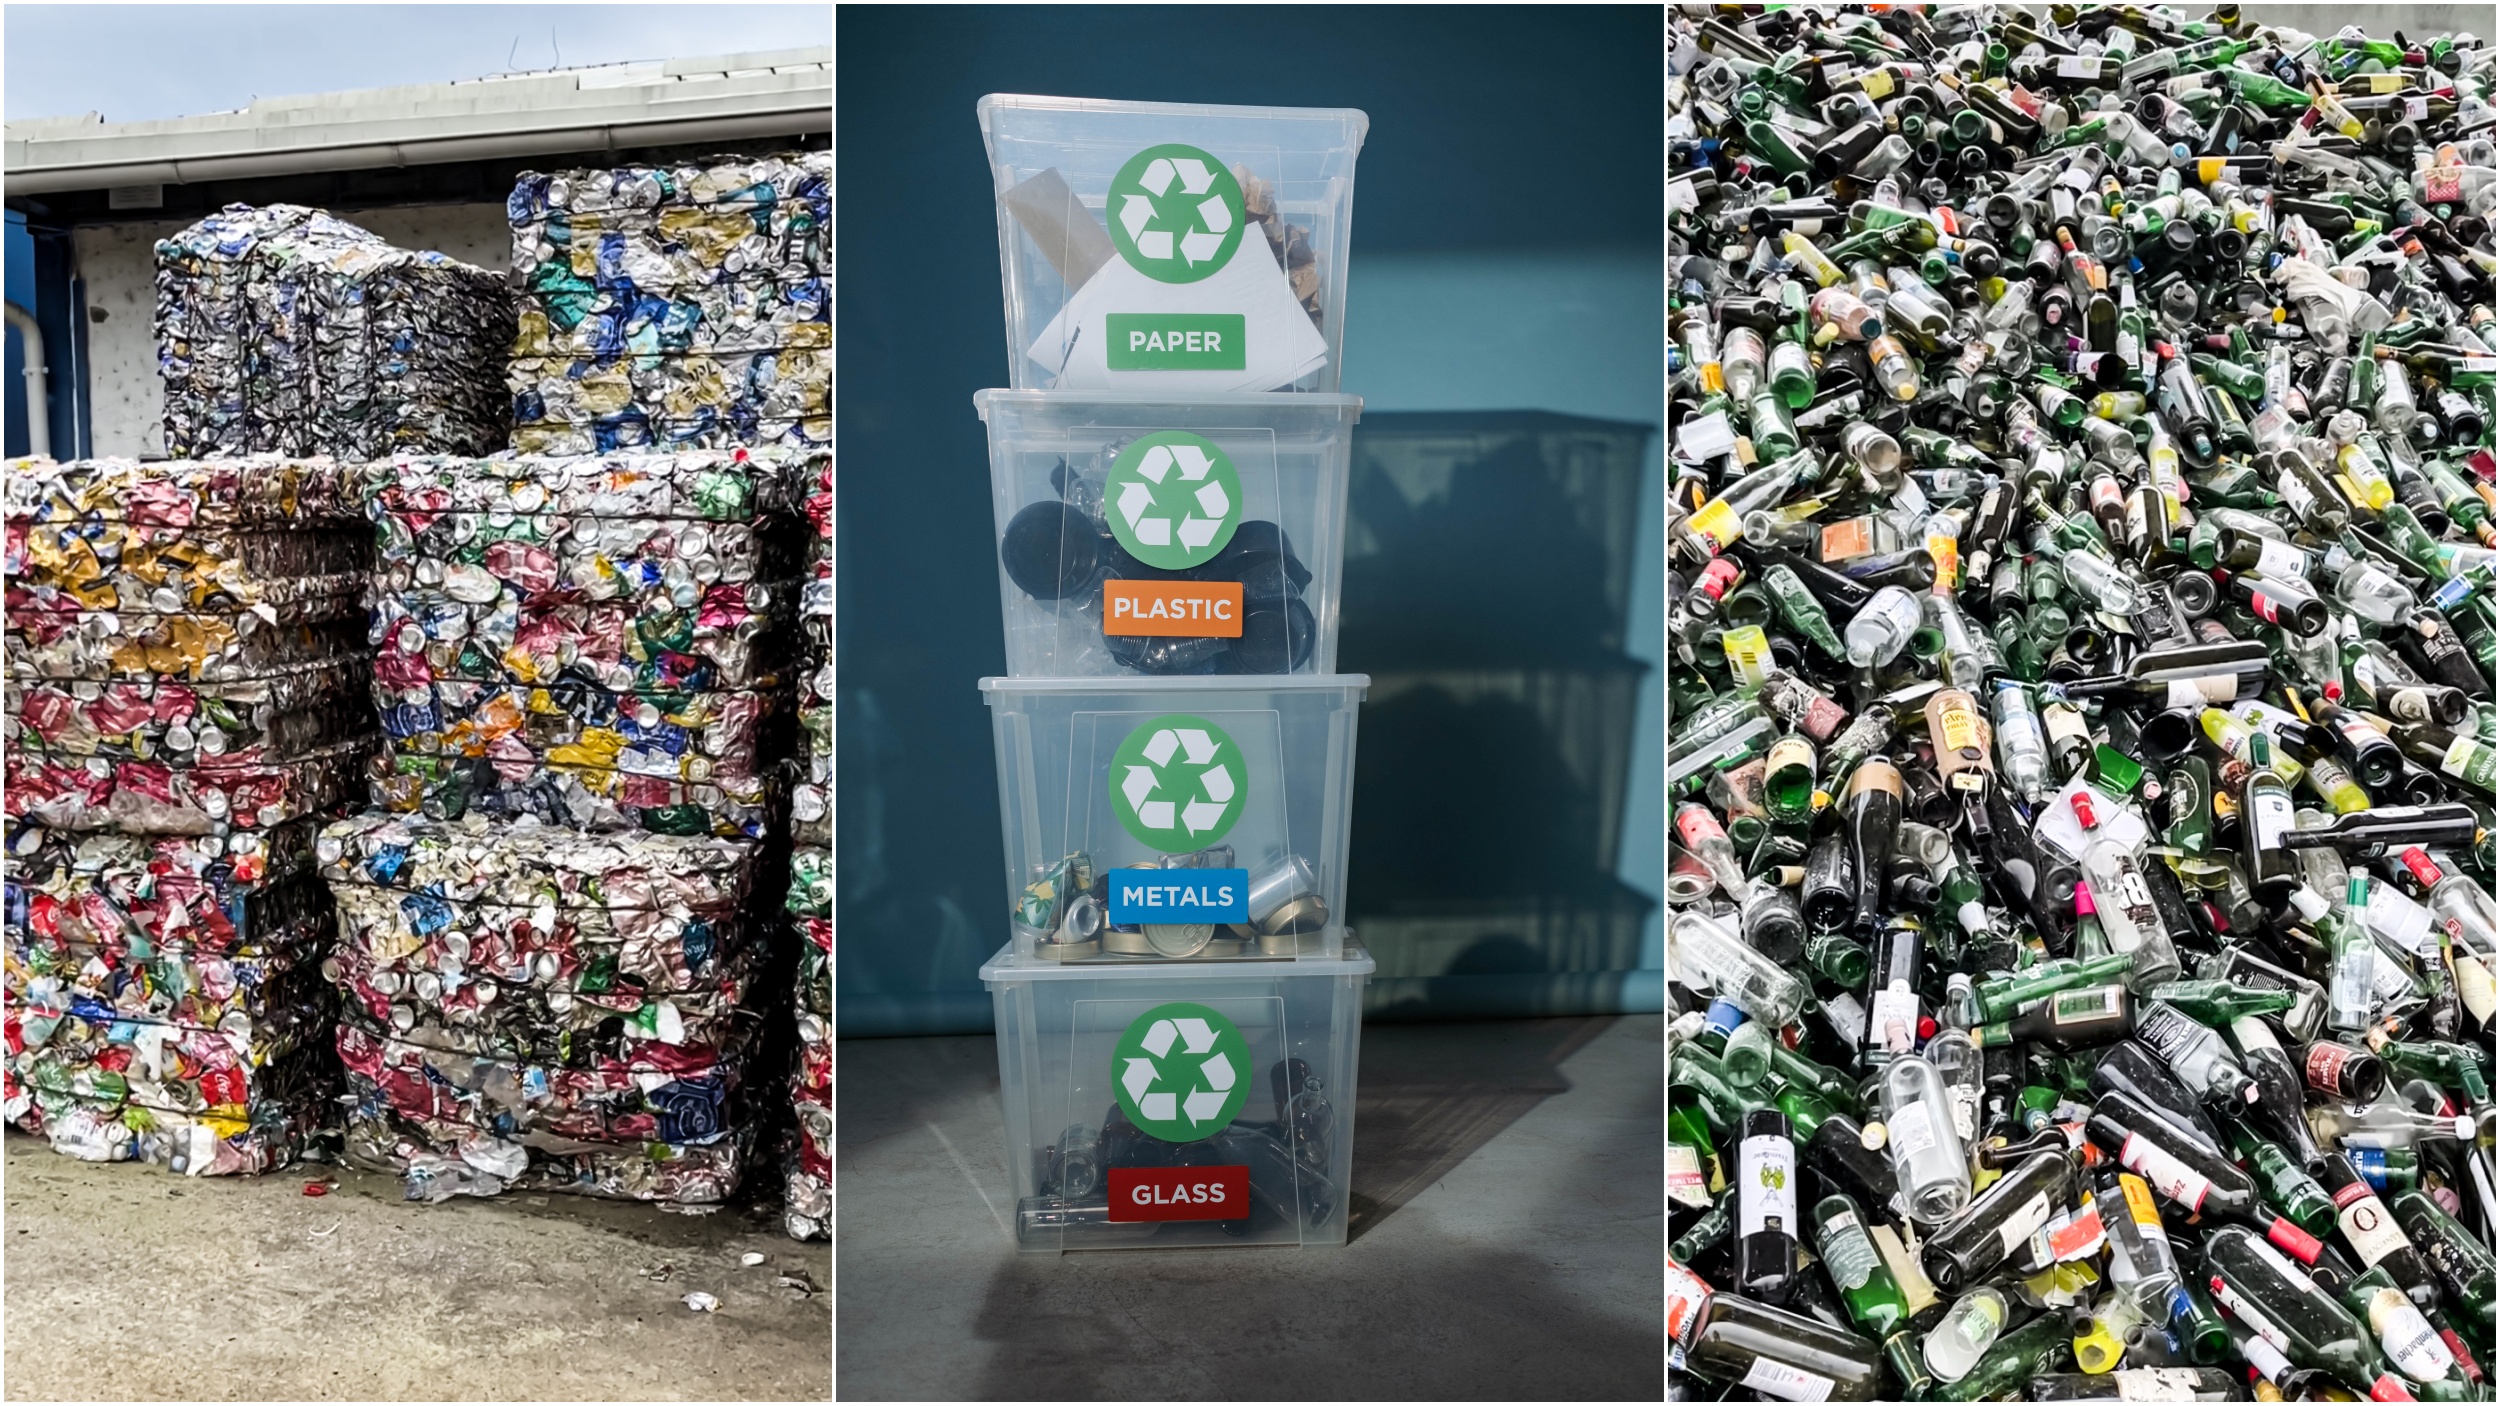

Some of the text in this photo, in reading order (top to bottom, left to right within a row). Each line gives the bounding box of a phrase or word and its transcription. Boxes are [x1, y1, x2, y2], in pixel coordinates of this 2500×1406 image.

[1129, 330, 1222, 352] PAPER
[1114, 597, 1232, 620] PLASTIC
[1122, 886, 1234, 907] METALS
[1131, 1182, 1226, 1205] GLASS
